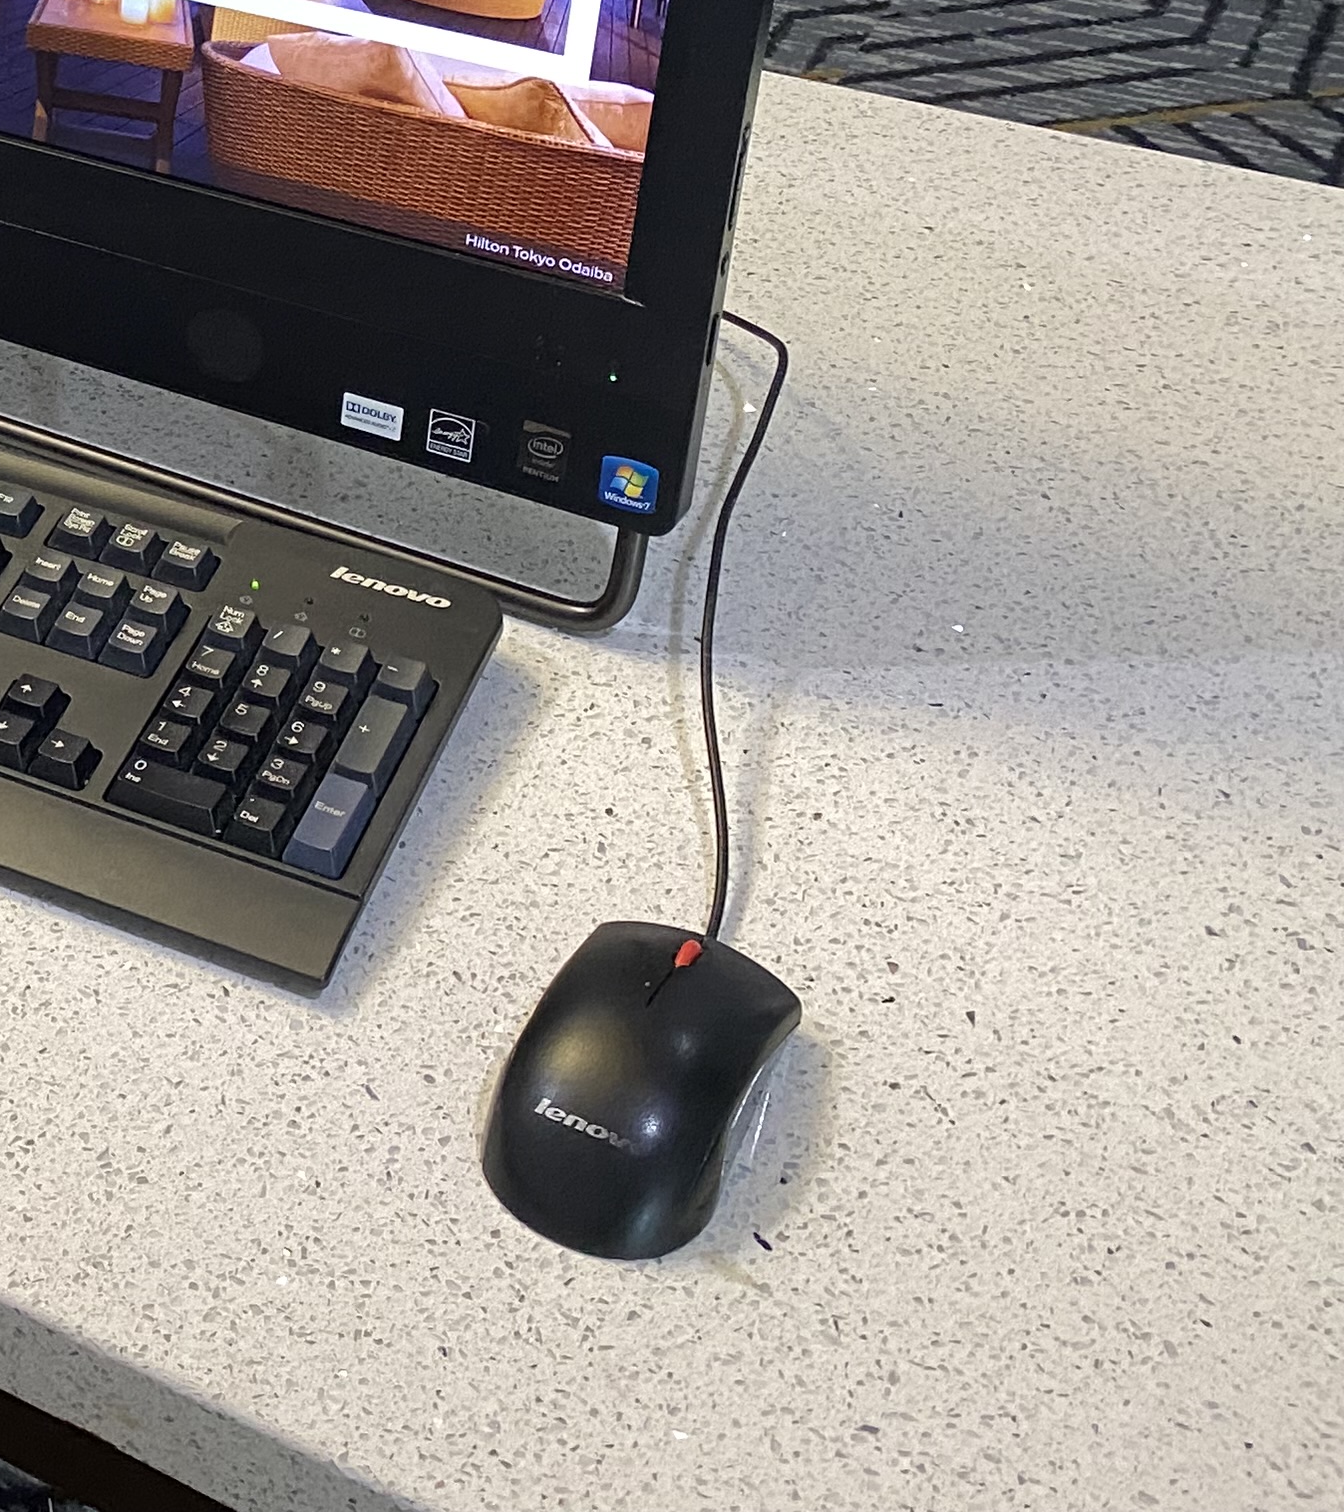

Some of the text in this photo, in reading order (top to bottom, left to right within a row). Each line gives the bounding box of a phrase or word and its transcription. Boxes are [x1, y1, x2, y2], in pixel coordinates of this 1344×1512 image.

[465, 233, 614, 283] Hilton Tokyo Odaiba
[361, 406, 397, 423] DOLBY
[429, 441, 452, 454] ENERGY
[522, 466, 559, 483] PENTIUM
[604, 491, 644, 509] Windows
[169, 548, 196, 561] Break
[173, 541, 202, 555] Pause
[35, 557, 61, 571] Insert
[87, 573, 114, 587] Home
[143, 585, 168, 599] Page
[330, 566, 452, 609] lenovo
[12, 595, 40, 609] Delete
[139, 592, 154, 603] Up
[64, 611, 86, 623] End
[219, 611, 243, 625] Lock
[223, 605, 245, 619] Num
[121, 624, 145, 638] Page
[117, 631, 144, 646] Down
[201, 645, 215, 657] 7
[191, 661, 220, 676] Home
[256, 665, 269, 676] 8
[178, 686, 192, 698] 4
[313, 681, 326, 693] 9
[235, 704, 248, 716] 5
[156, 721, 167, 731] 1
[291, 721, 304, 733] 6
[147, 733, 169, 746] End
[213, 740, 228, 752] 2
[134, 759, 147, 771] 0
[270, 758, 284, 770] 3
[124, 772, 142, 783] Ins
[261, 770, 290, 786] PgDn
[240, 809, 259, 823] Del
[314, 800, 346, 818] Enter
[534, 1098, 634, 1150] lenov
